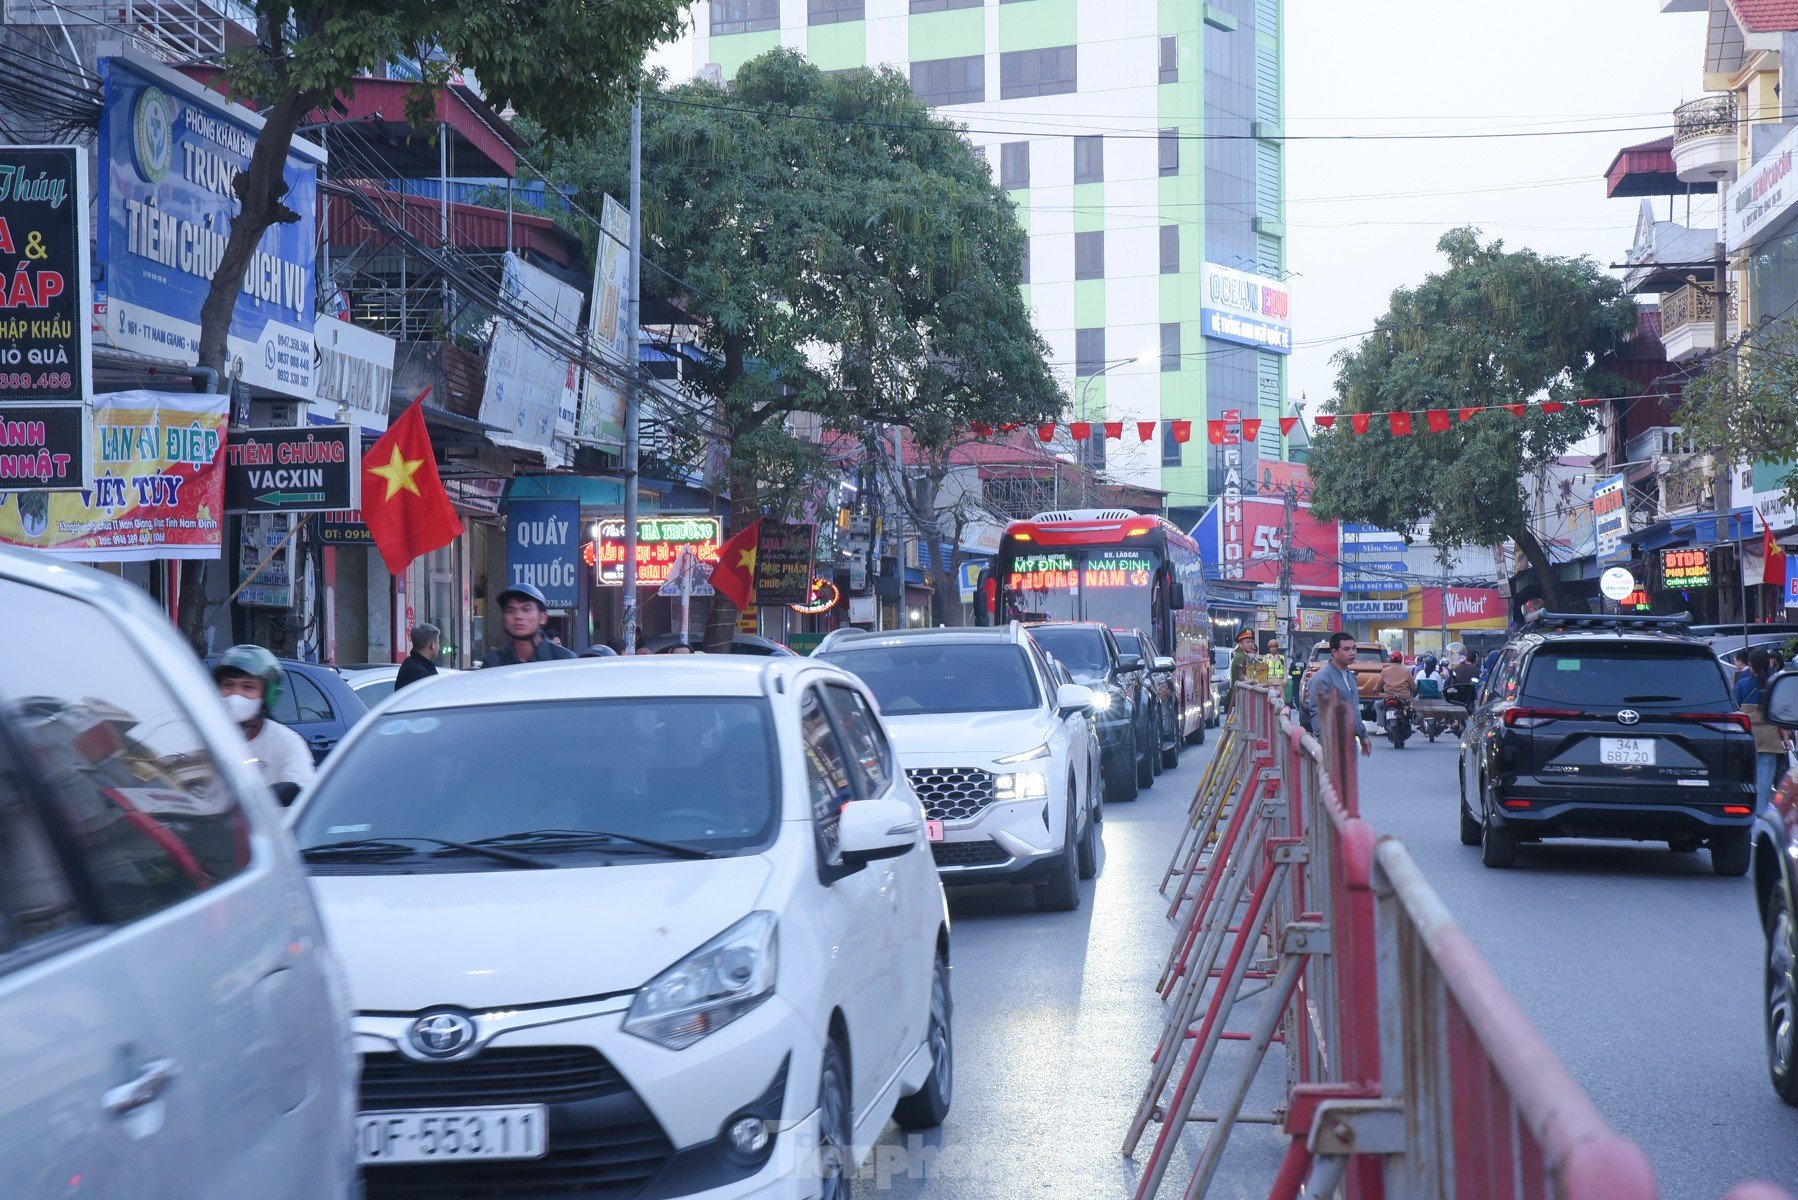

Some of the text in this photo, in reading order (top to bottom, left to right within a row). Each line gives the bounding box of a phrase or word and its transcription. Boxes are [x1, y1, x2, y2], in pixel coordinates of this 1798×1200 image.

[186, 107, 215, 144] PHÒNG
[216, 124, 240, 155] KHÁM
[25, 231, 48, 260] &
[126, 196, 177, 270] TIÊM
[177, 213, 230, 282] CHỦN
[284, 261, 305, 322] VỤ
[1210, 272, 1289, 320] OCEAN EDU
[31, 312, 71, 339] KHẨU
[127, 320, 137, 335] 161
[142, 324, 152, 340] TT
[151, 328, 166, 343] NAM
[166, 331, 186, 350] GIANG
[190, 339, 201, 352] NA
[27, 343, 69, 364] QUÀ
[98, 424, 136, 464] LAN
[165, 420, 220, 472] ĐIỆP
[228, 437, 274, 466] TIÊM
[277, 433, 345, 465] CHỦNG
[0, 447, 70, 483] NHẬT
[247, 468, 323, 489] VACXIN
[132, 468, 183, 508] TÚY
[119, 519, 134, 530] Nam
[179, 518, 197, 528] Nam
[198, 517, 218, 531] Định
[324, 529, 341, 539] ĐT:
[517, 514, 569, 546] QUẦY
[1383, 544, 1398, 552] Non
[512, 556, 575, 587] THUỐC
[1085, 570, 1126, 588] NAM
[1088, 560, 1116, 571] NAM
[1346, 602, 1381, 612] OCEAN
[1382, 602, 1404, 611] EDU
[1606, 751, 1649, 763] 687.20
[1616, 738, 1639, 751] 34A
[360, 1113, 533, 1158] 0F-553.11
